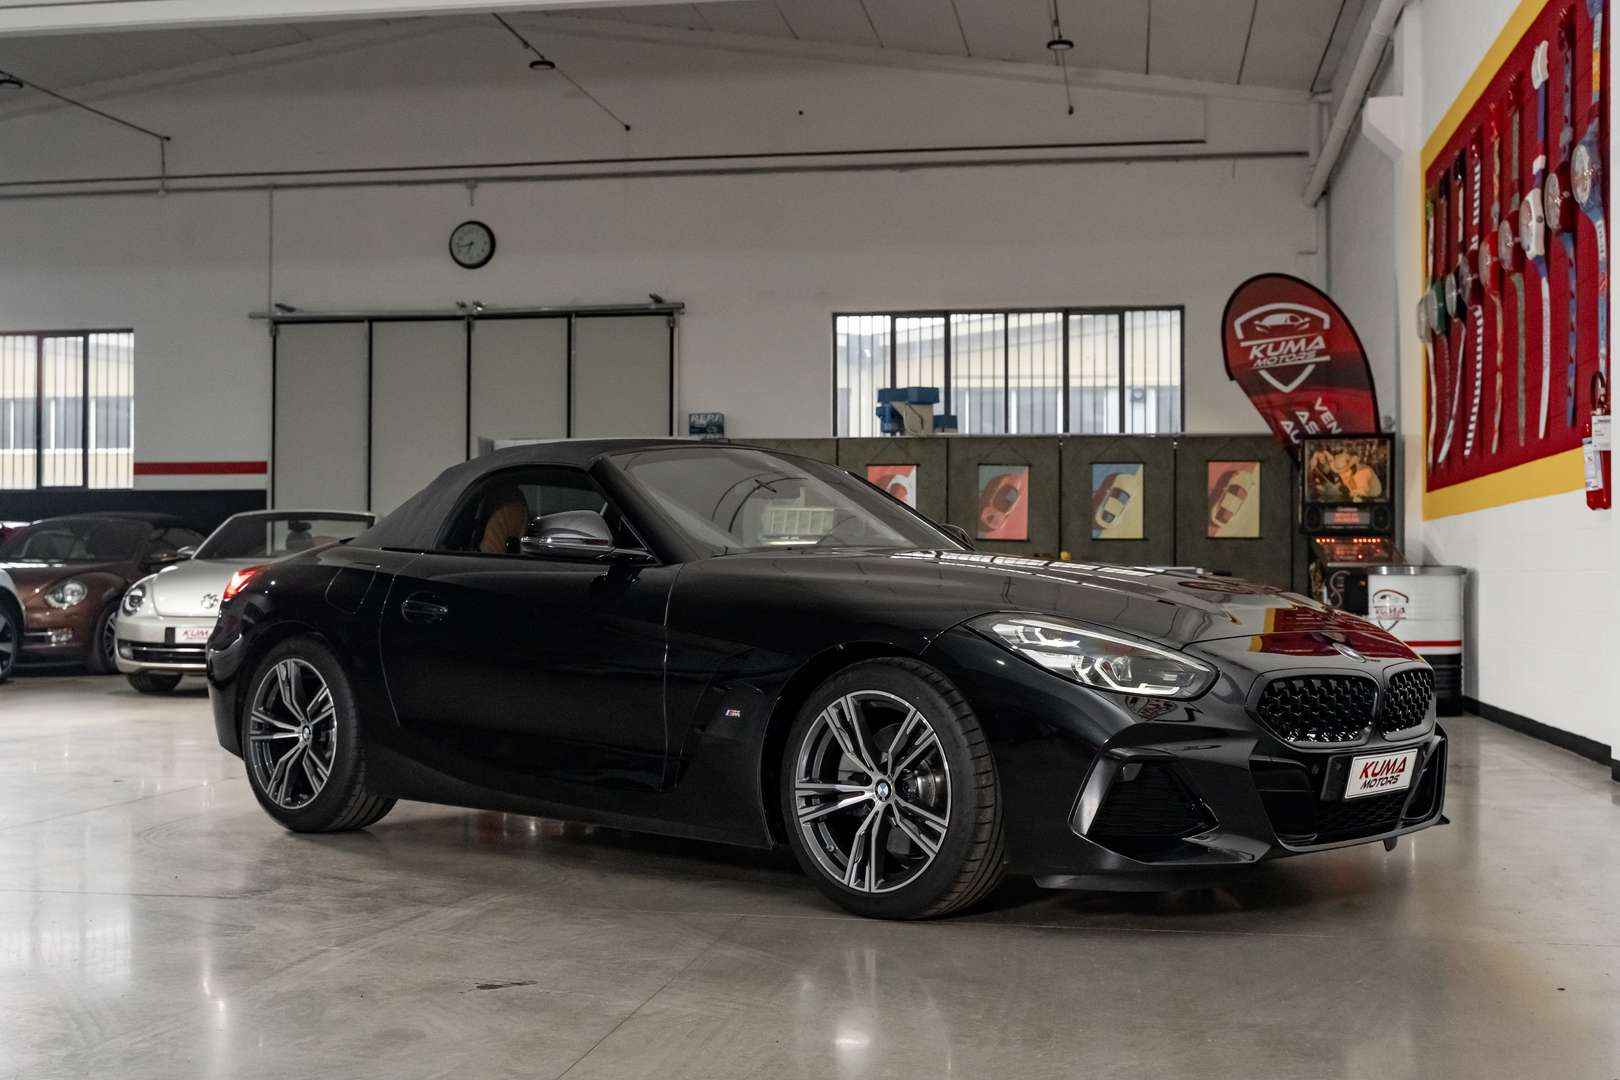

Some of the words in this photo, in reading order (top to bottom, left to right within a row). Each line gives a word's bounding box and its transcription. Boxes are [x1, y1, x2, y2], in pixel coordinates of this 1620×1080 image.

[1249, 335, 1326, 360] KUMA
[1253, 350, 1316, 369] MOTORS
[1359, 756, 1408, 779] KUMA
[1360, 775, 1401, 790] MOTORS
